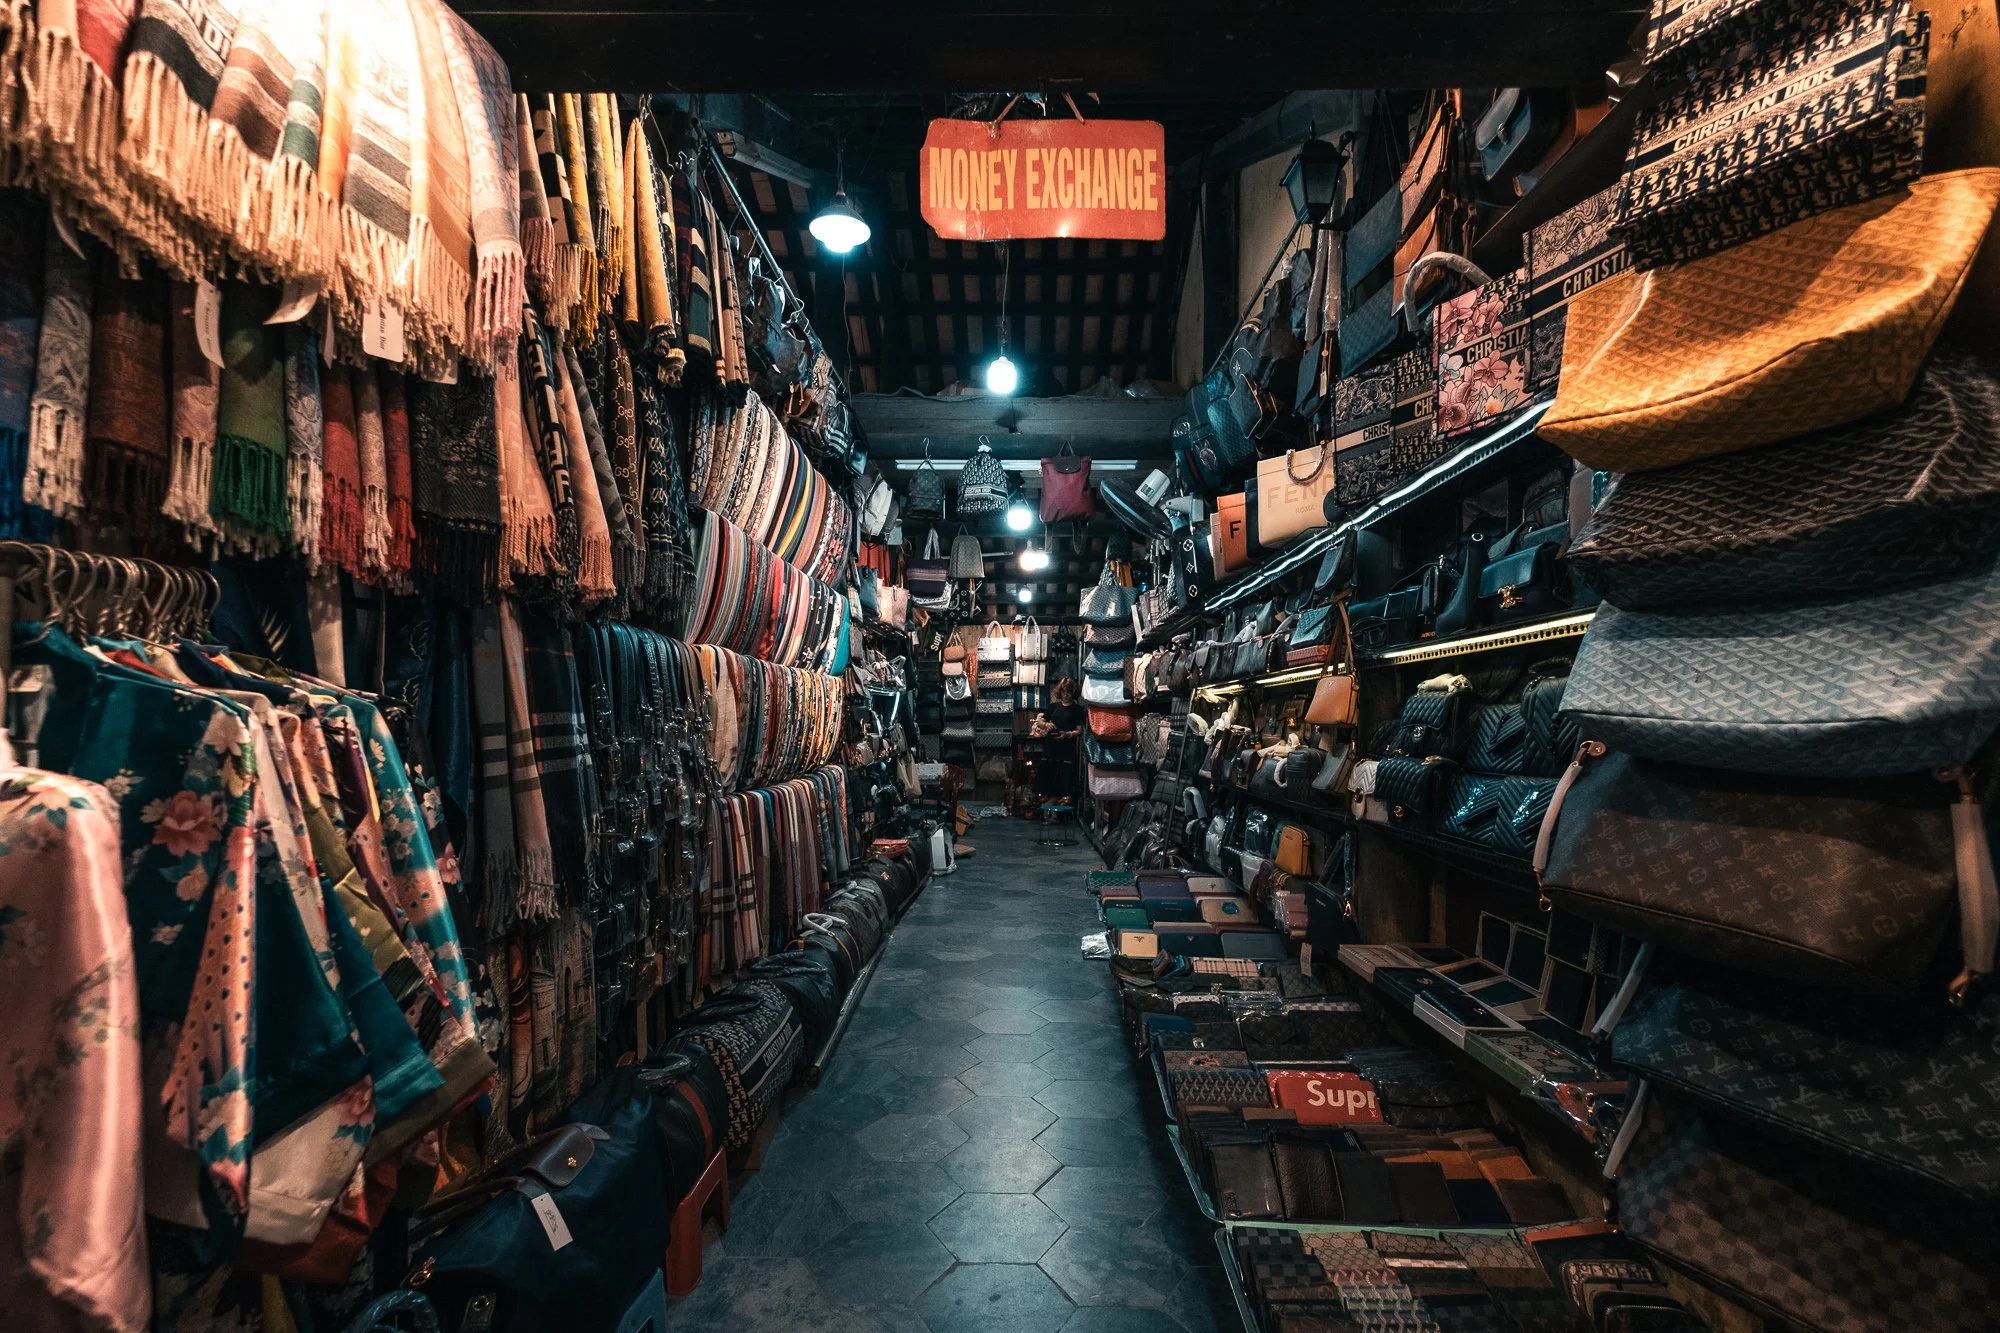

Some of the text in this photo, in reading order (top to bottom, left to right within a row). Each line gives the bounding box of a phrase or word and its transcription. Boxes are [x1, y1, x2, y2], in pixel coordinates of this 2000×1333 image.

[1673, 67, 1835, 151] CHRISTIAN DIOR
[929, 147, 1158, 211] MONEY EXCHANGE
[1229, 520, 1241, 539] F
